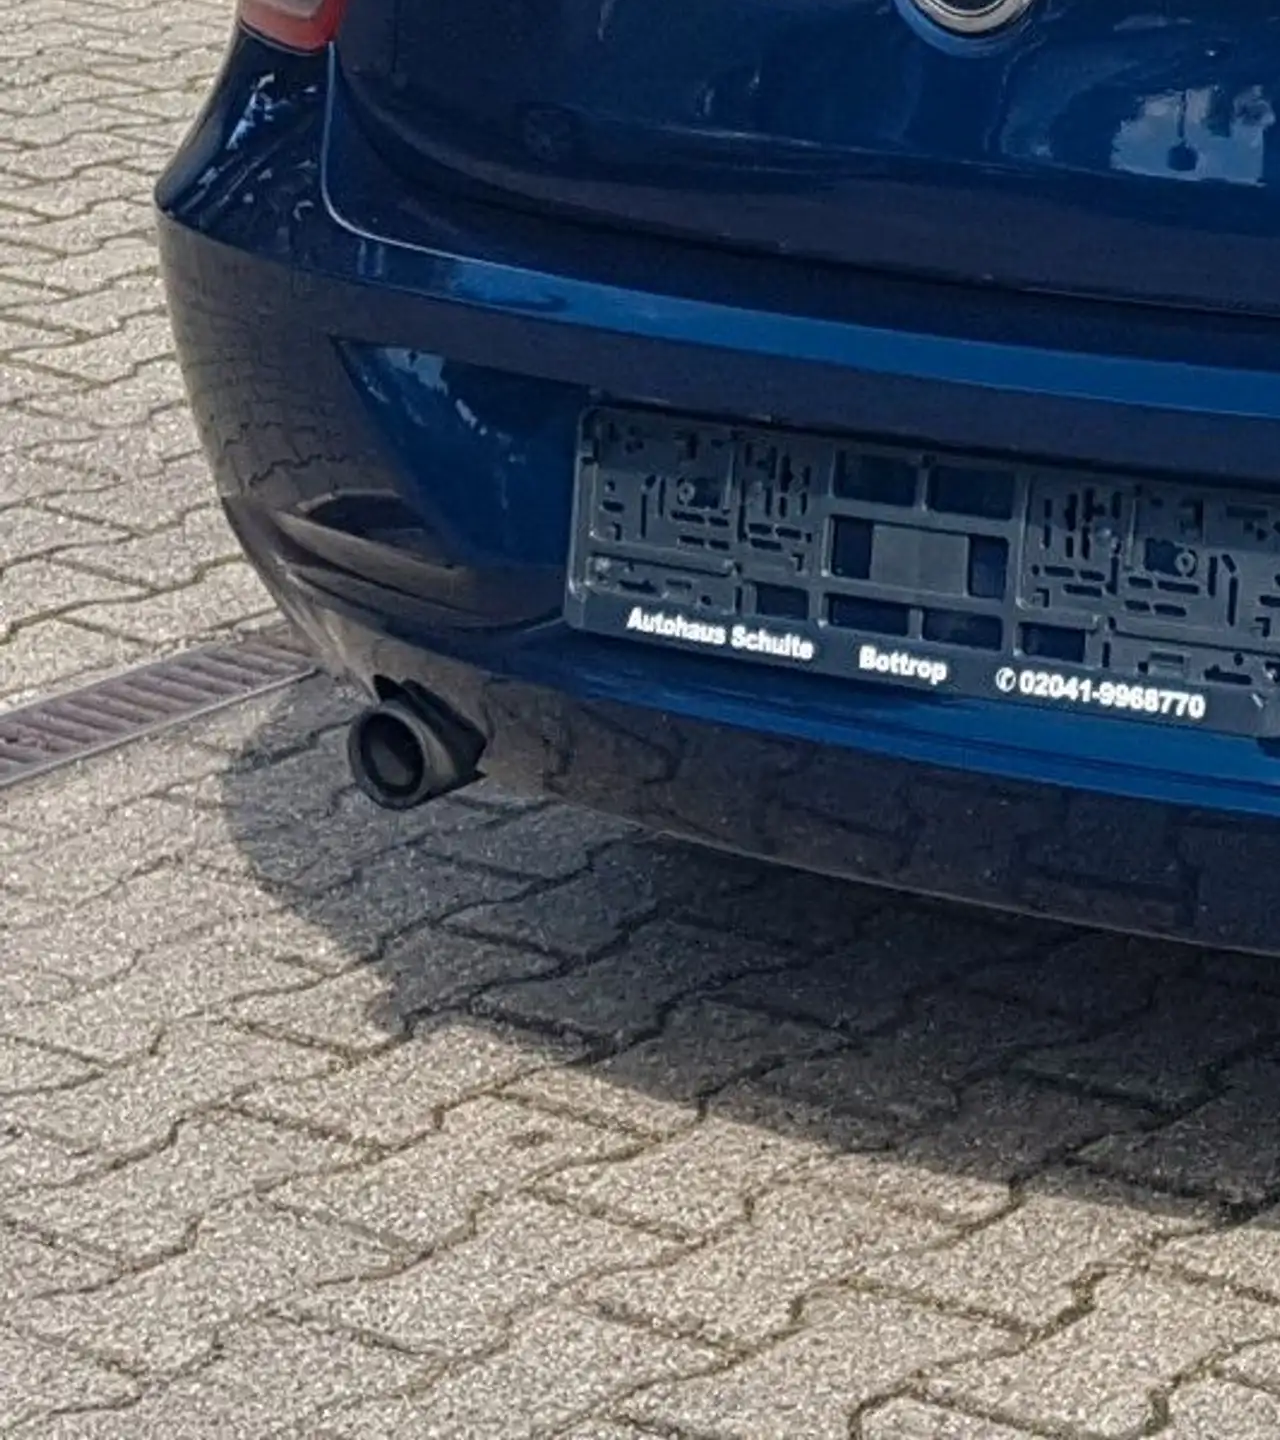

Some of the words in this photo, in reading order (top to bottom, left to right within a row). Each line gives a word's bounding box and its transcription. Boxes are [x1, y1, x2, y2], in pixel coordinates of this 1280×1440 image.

[627, 606, 726, 645] Autohaus
[731, 624, 815, 660] Schulte
[859, 645, 948, 685] Bottrop
[1019, 670, 1206, 719] 02041-9968770
